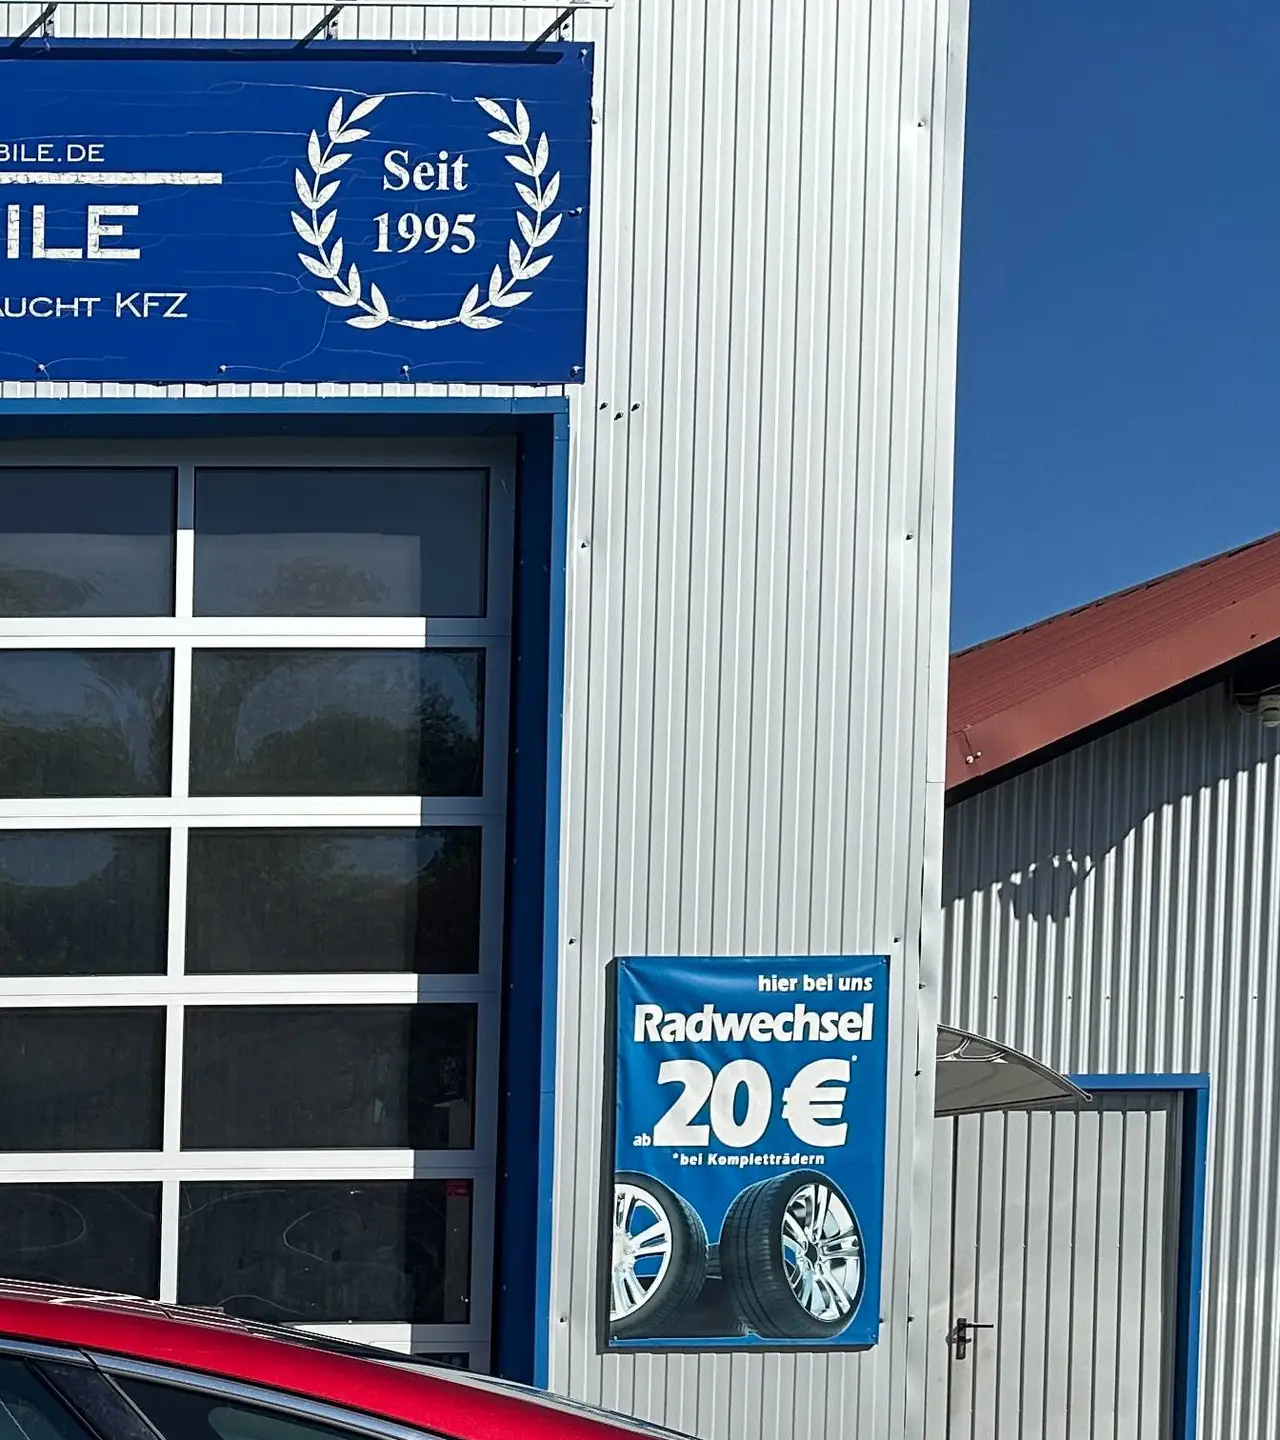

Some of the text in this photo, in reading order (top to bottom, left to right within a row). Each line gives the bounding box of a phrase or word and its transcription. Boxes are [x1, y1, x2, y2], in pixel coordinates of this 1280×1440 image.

[382, 149, 470, 192] Seit
[372, 212, 477, 255] 1995
[115, 292, 188, 318] KFZ
[758, 974, 873, 992] hier bei uns
[633, 1002, 874, 1043] Radwechsel
[633, 1132, 651, 1147] ab
[653, 1058, 772, 1148] 20
[707, 1152, 825, 1170] Kompletträdern
